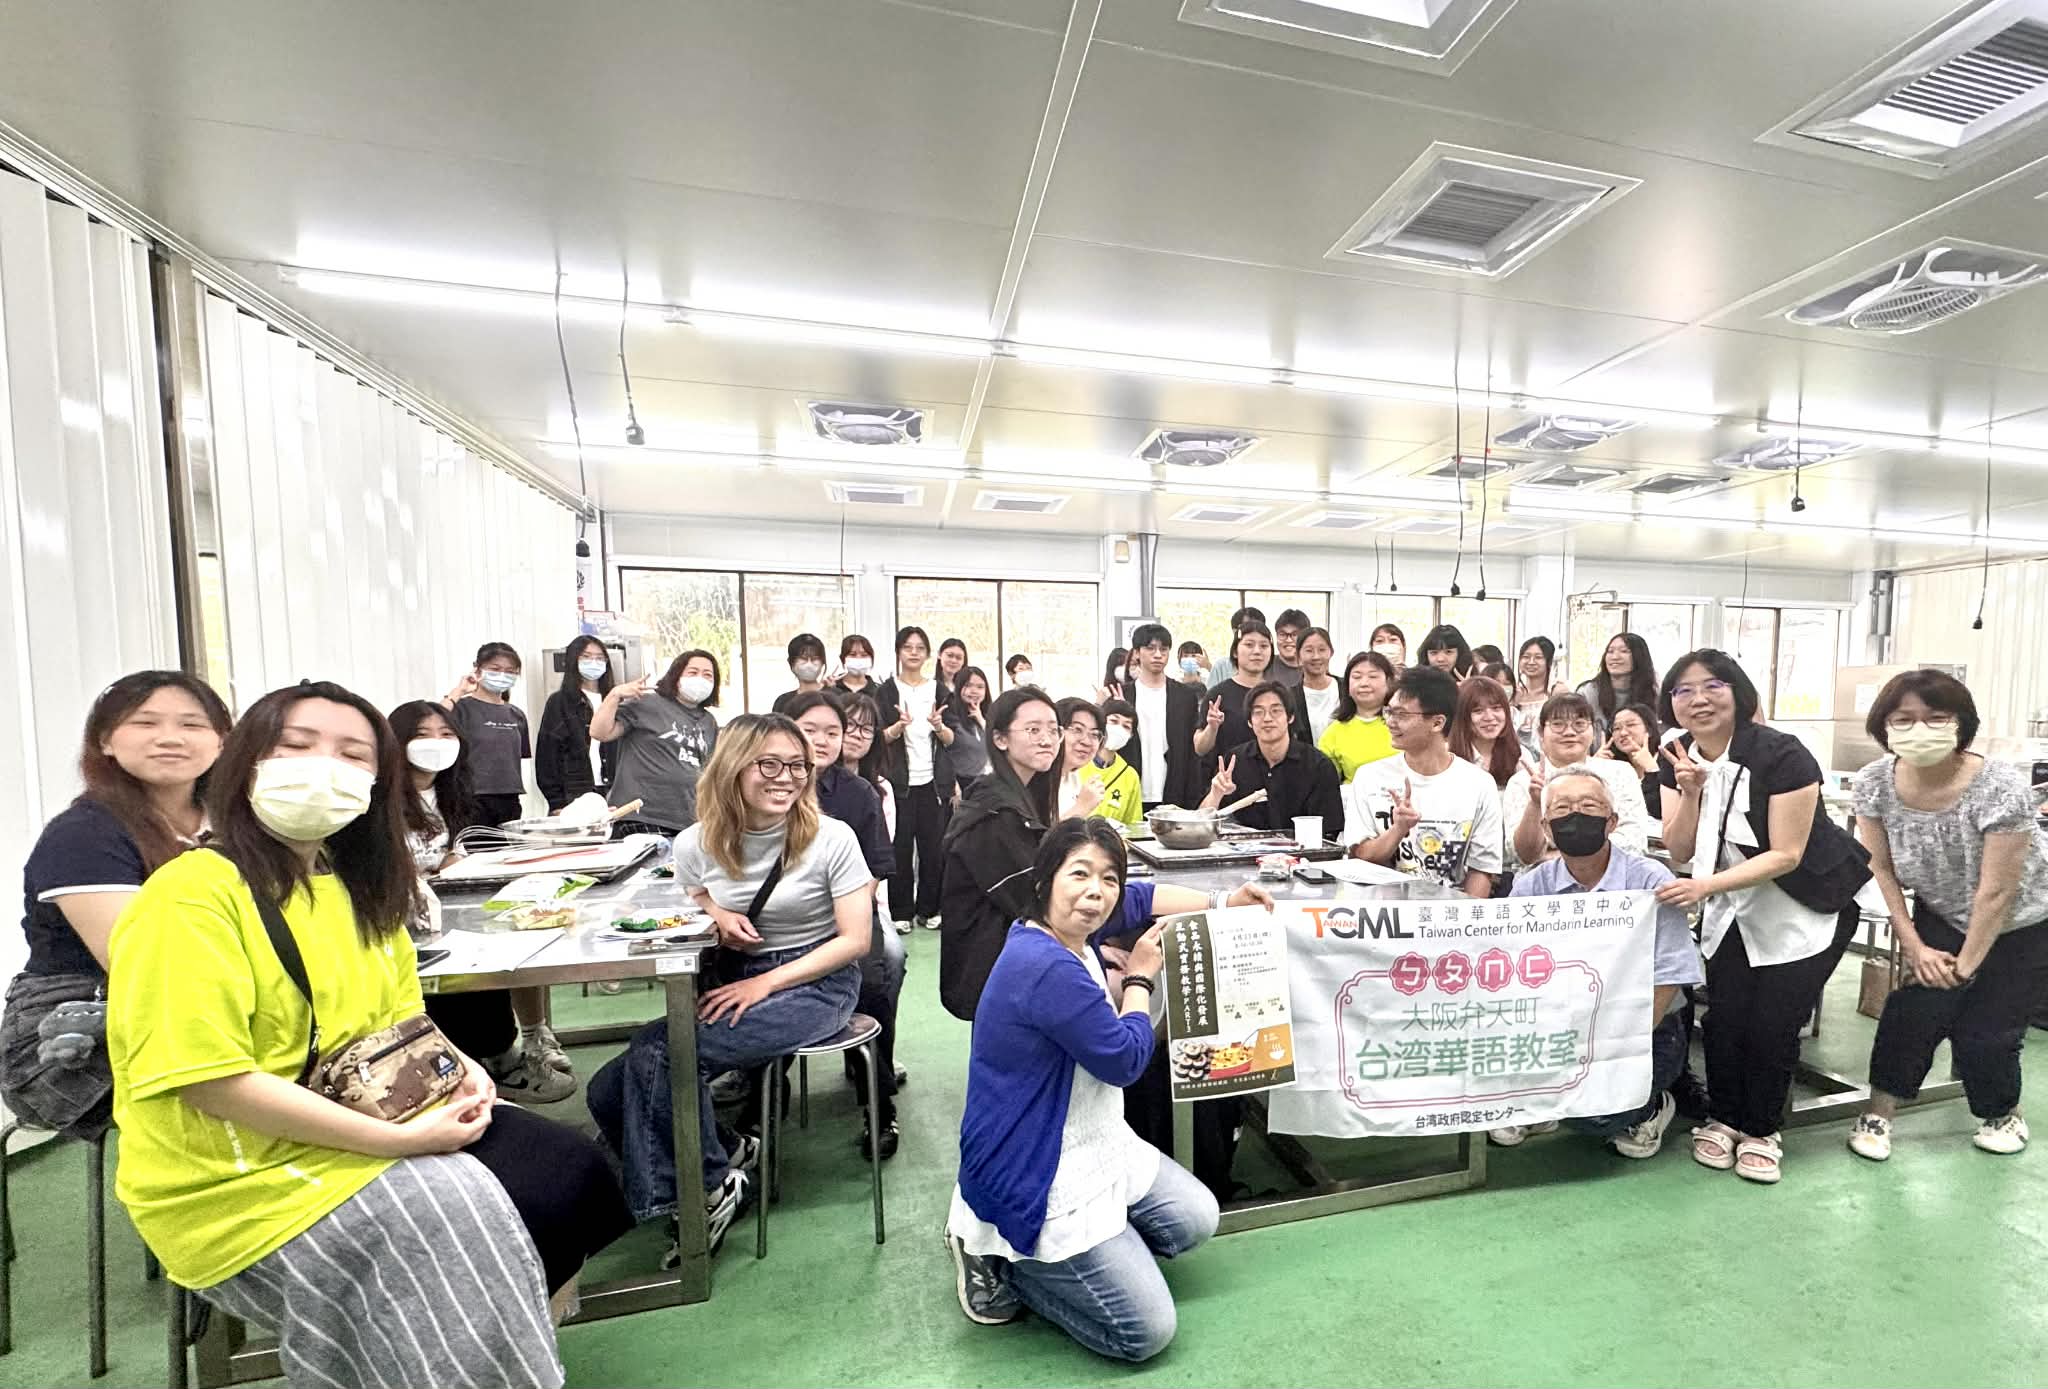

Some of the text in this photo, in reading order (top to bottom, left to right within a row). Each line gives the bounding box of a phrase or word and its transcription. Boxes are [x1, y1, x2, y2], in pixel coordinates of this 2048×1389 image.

[1302, 907, 1415, 939] TCML
[1418, 895, 1633, 922] 臺灣華語文學習中心
[1418, 915, 1634, 938] Taiwan Center for Mandarin Learning
[1400, 997, 1542, 1031] 大阪弁天町
[1355, 1029, 1580, 1080] 台湾華語教室
[1415, 1106, 1526, 1128] 台湾政府認定センター
